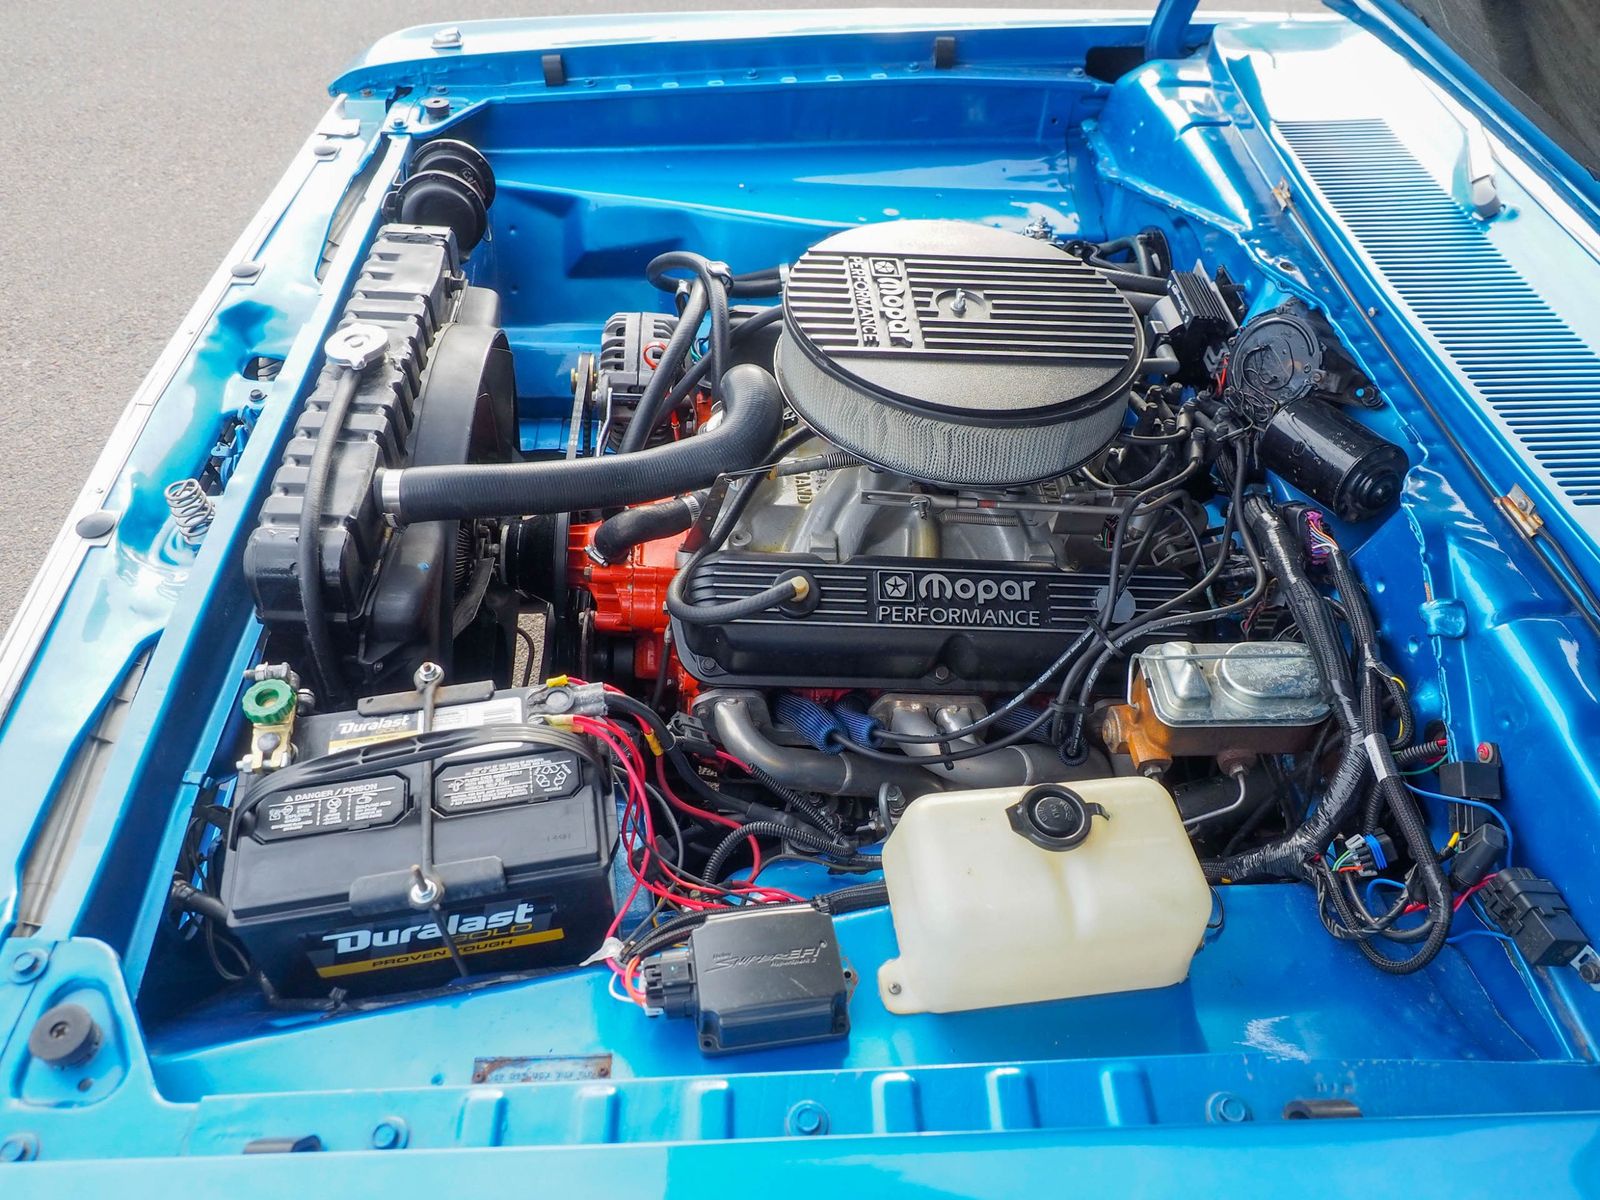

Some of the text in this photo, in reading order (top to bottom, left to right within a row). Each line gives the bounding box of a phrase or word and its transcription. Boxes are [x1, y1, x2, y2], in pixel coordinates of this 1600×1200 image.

[848, 256, 880, 345] PERFORMANCE
[877, 277, 913, 345] Mopar
[918, 573, 1036, 604] Mopar
[878, 605, 1041, 626] PERFORMANCE
[338, 714, 410, 735] Duralast
[295, 789, 333, 802] DANGER
[342, 782, 378, 795] POISON
[321, 902, 534, 954] Duralast
[372, 949, 447, 968] PROVEN
